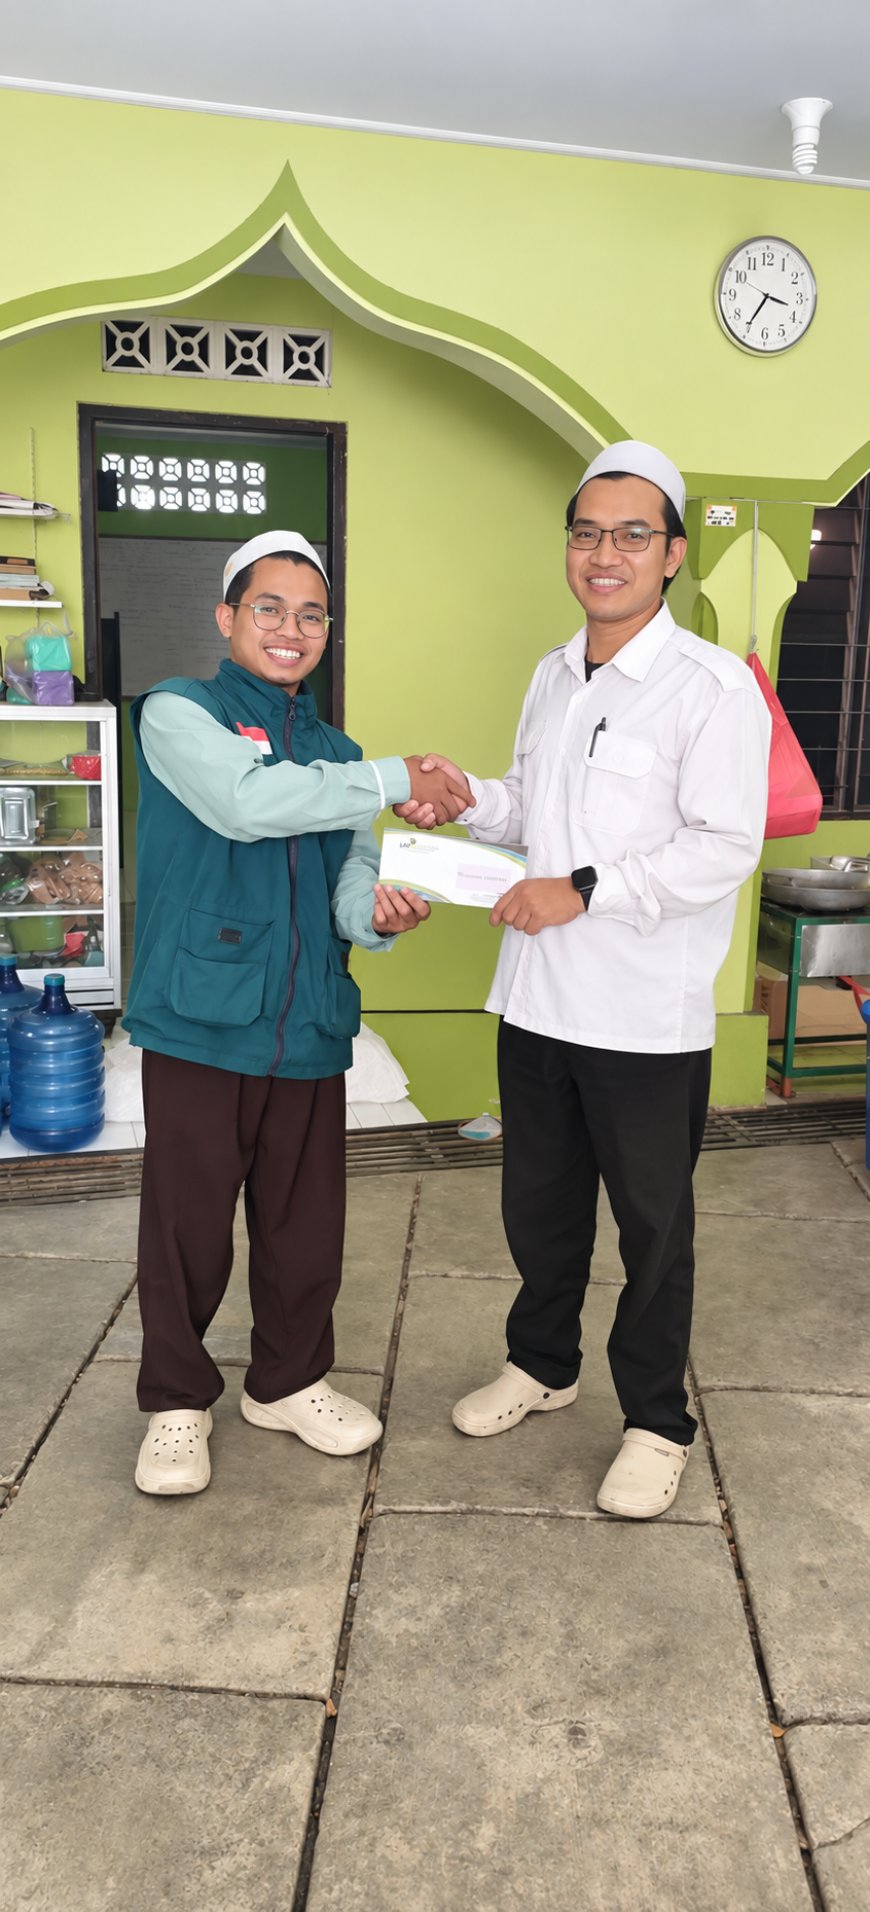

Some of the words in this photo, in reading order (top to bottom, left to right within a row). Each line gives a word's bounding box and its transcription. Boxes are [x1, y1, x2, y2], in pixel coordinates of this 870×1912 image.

[747, 256, 757, 271] 11
[762, 252, 775, 266] 12
[781, 258, 786, 272] 1
[735, 270, 747, 284] 10
[791, 272, 799, 285] 2
[728, 288, 737, 301] 9
[796, 292, 803, 305] 3
[733, 308, 741, 320] 8
[789, 310, 796, 323] 4
[745, 321, 752, 334] 7
[761, 327, 769, 340] 6
[777, 324, 786, 337] 5
